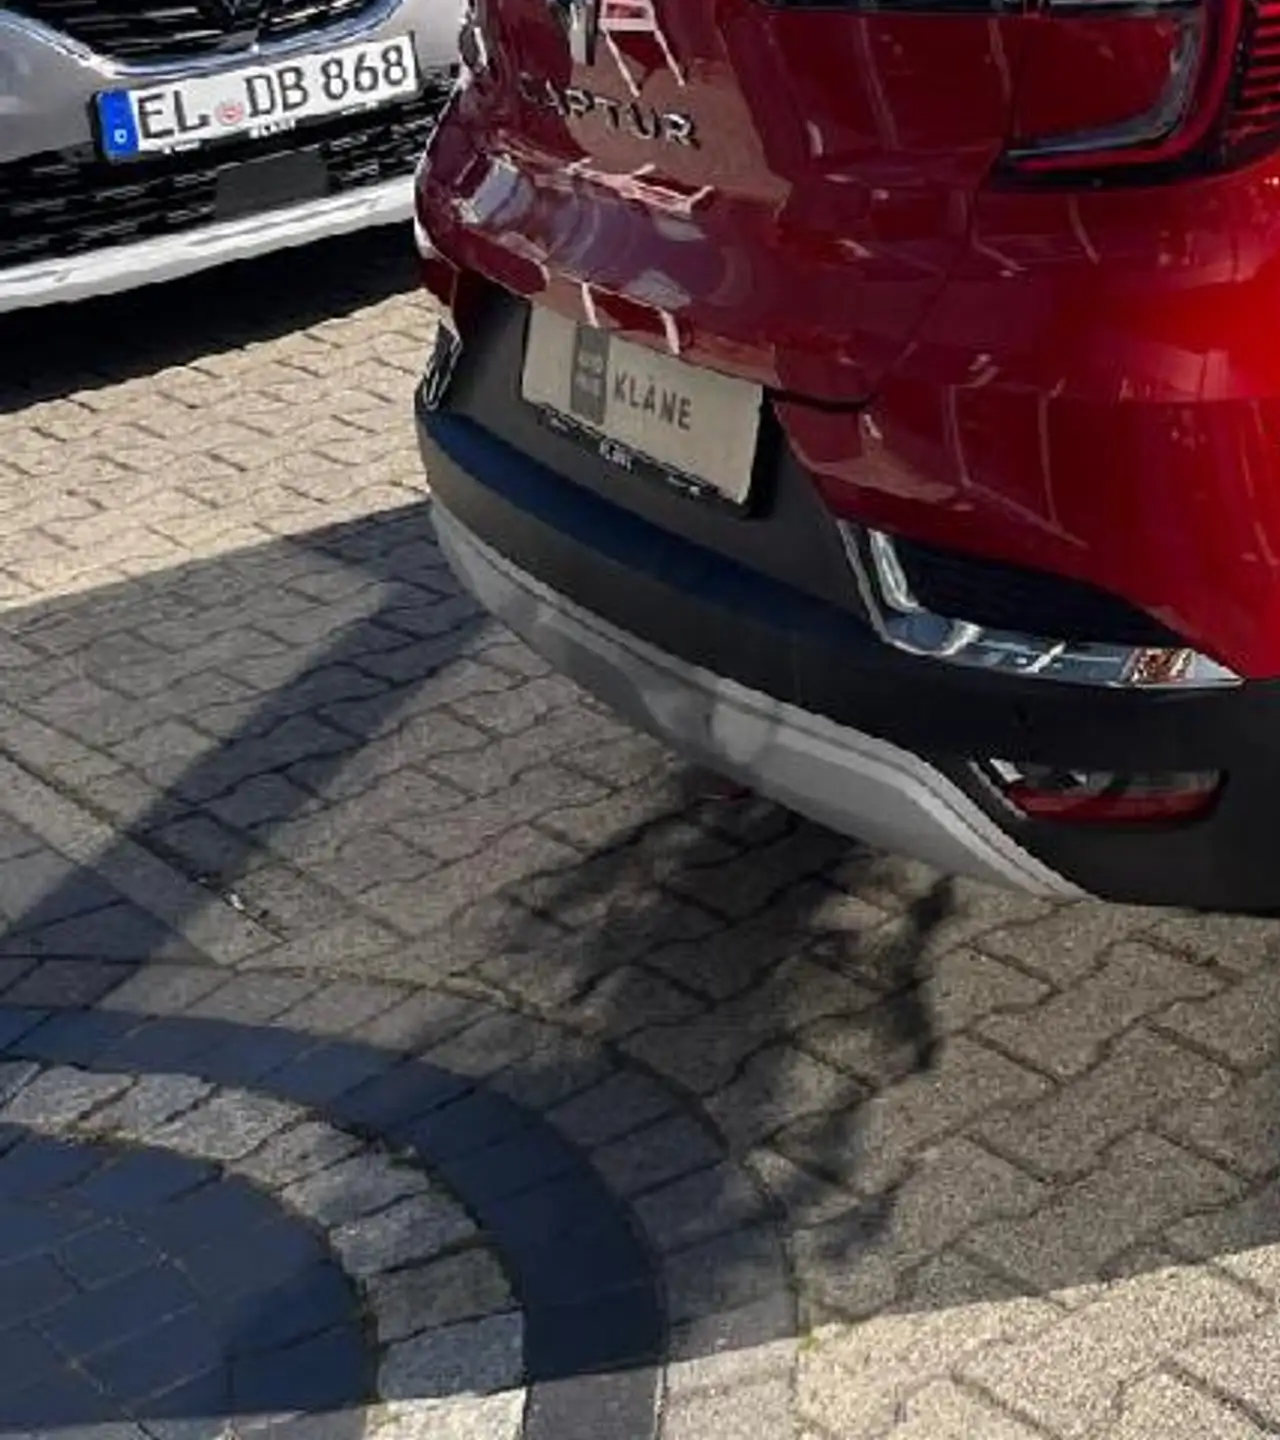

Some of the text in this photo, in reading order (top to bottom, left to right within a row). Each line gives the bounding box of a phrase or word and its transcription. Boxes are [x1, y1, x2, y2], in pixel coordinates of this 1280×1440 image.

[137, 89, 211, 140] EL
[245, 64, 309, 118] DB
[320, 43, 408, 101] 868
[519, 71, 701, 151] CAPTUR
